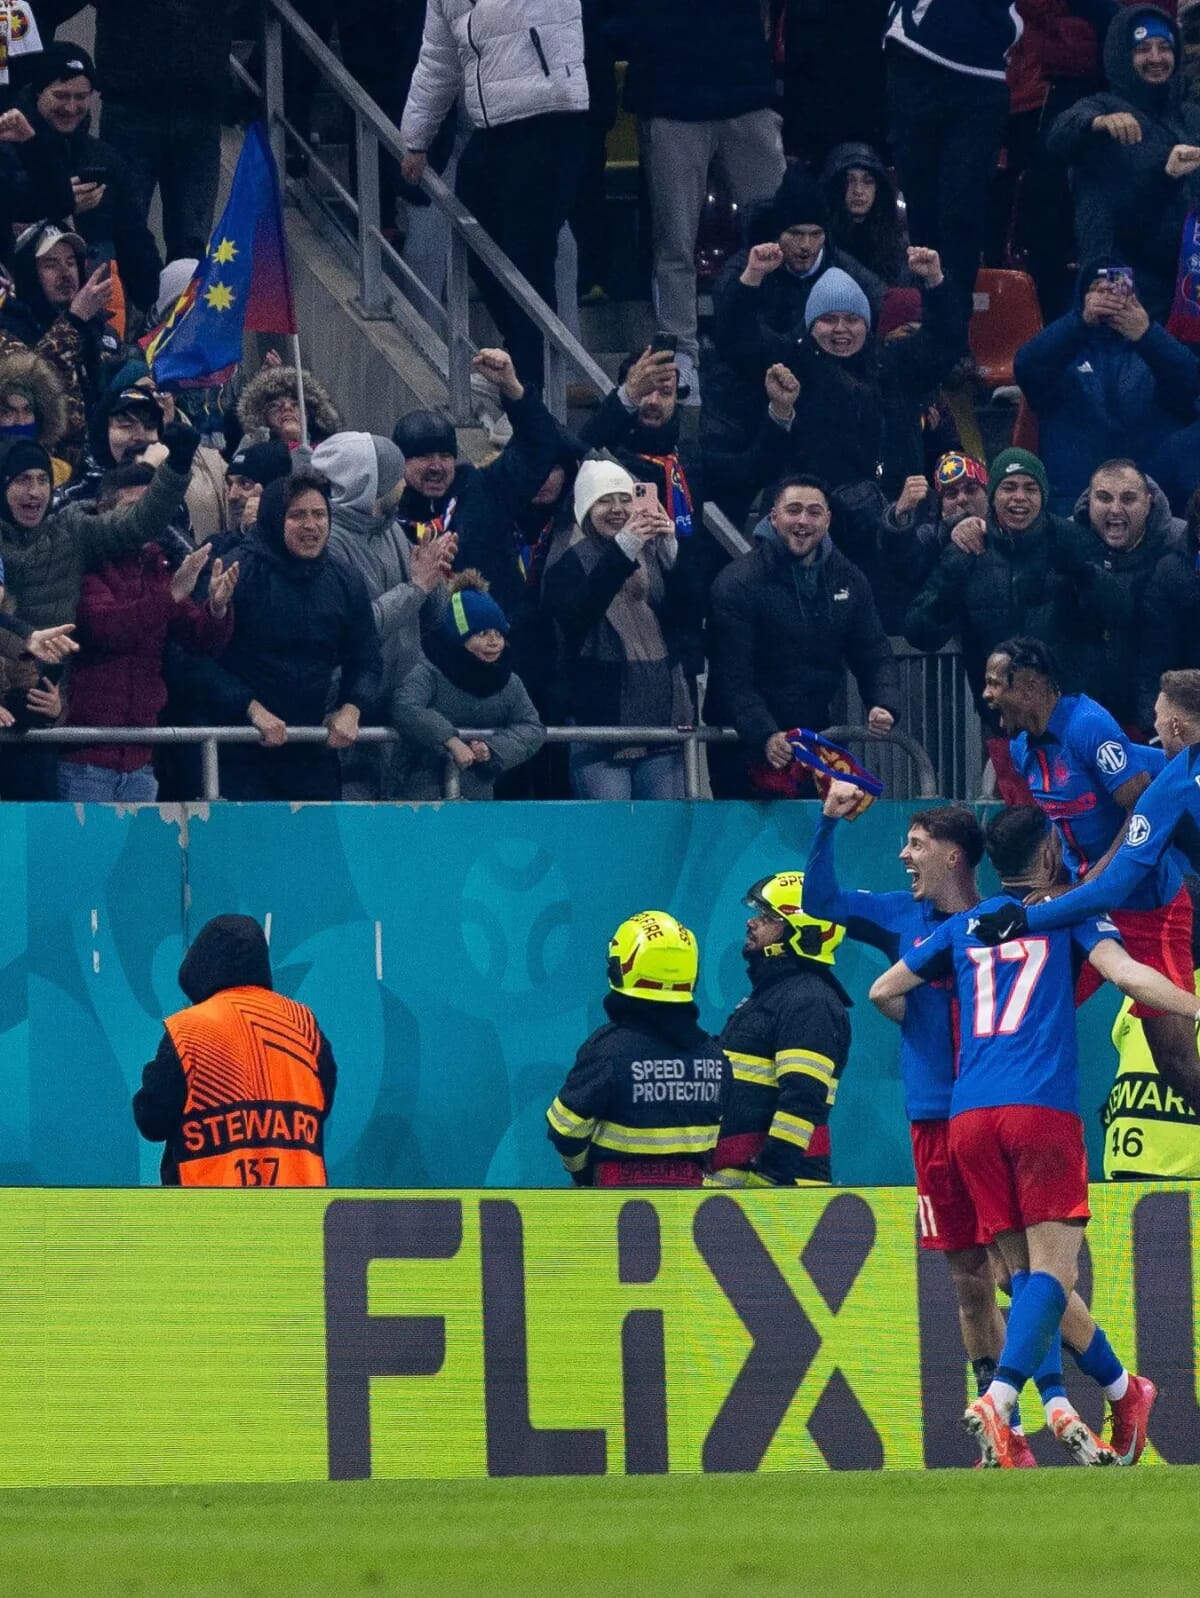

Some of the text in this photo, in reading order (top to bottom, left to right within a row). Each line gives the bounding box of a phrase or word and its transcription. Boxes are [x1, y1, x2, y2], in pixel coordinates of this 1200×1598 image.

[1096, 741, 1127, 774] MG
[966, 936, 1049, 1037] 17
[631, 1059, 723, 1081] SPEED FIRE
[182, 1109, 318, 1151] STEWARD
[1112, 1127, 1145, 1158] 46
